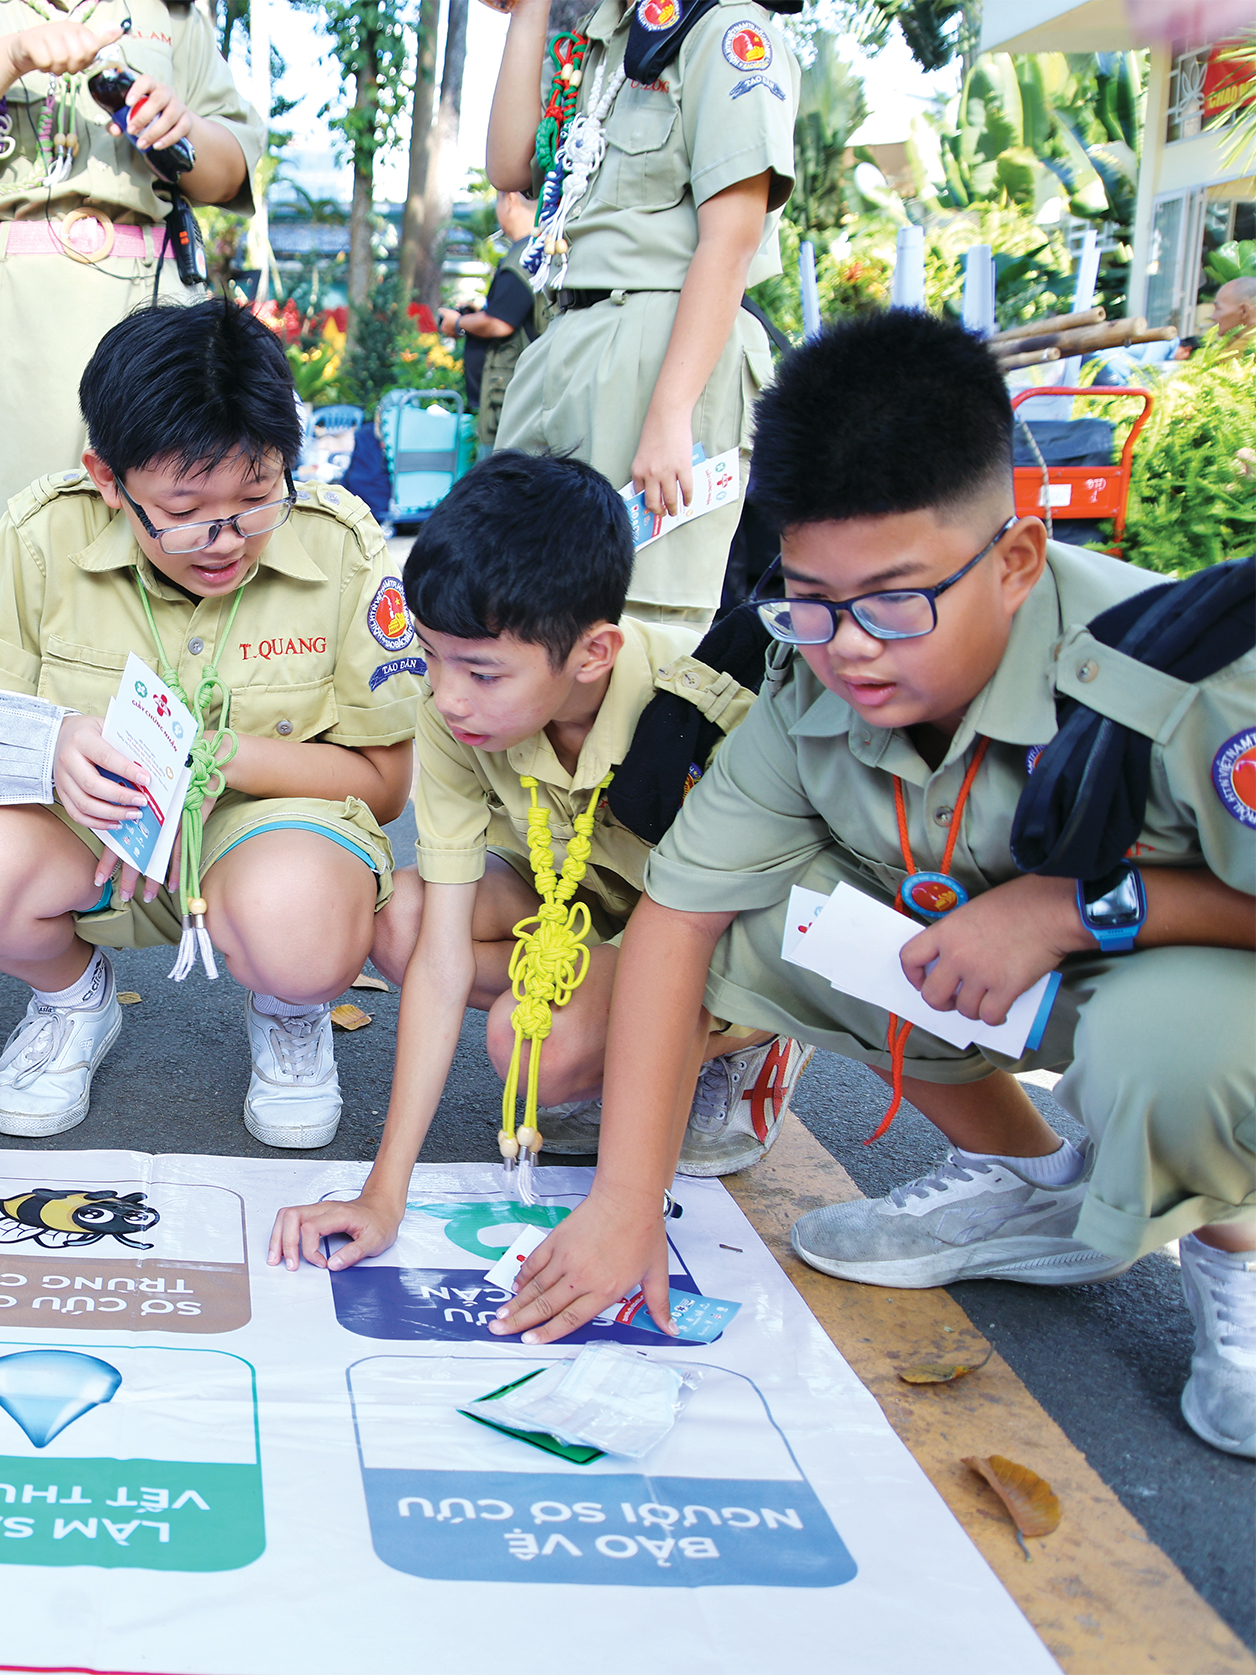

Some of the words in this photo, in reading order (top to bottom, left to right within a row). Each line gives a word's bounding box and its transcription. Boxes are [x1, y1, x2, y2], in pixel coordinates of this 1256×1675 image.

[239, 637, 327, 660] T.QUANG
[381, 662, 398, 675] TAO
[42, 1275, 194, 1294] TRÙNG
[420, 1285, 513, 1307] CẮN
[31, 1296, 127, 1315] CỨU
[140, 1299, 202, 1316] SƠ
[105, 1486, 211, 1514] VẾT
[398, 1496, 514, 1524] CỨU
[530, 1500, 607, 1525] SƠ
[621, 1502, 804, 1531] NGƯỜI
[53, 1517, 170, 1547] LÀM
[504, 1527, 583, 1561] VỆ
[595, 1534, 720, 1567] BẢO
